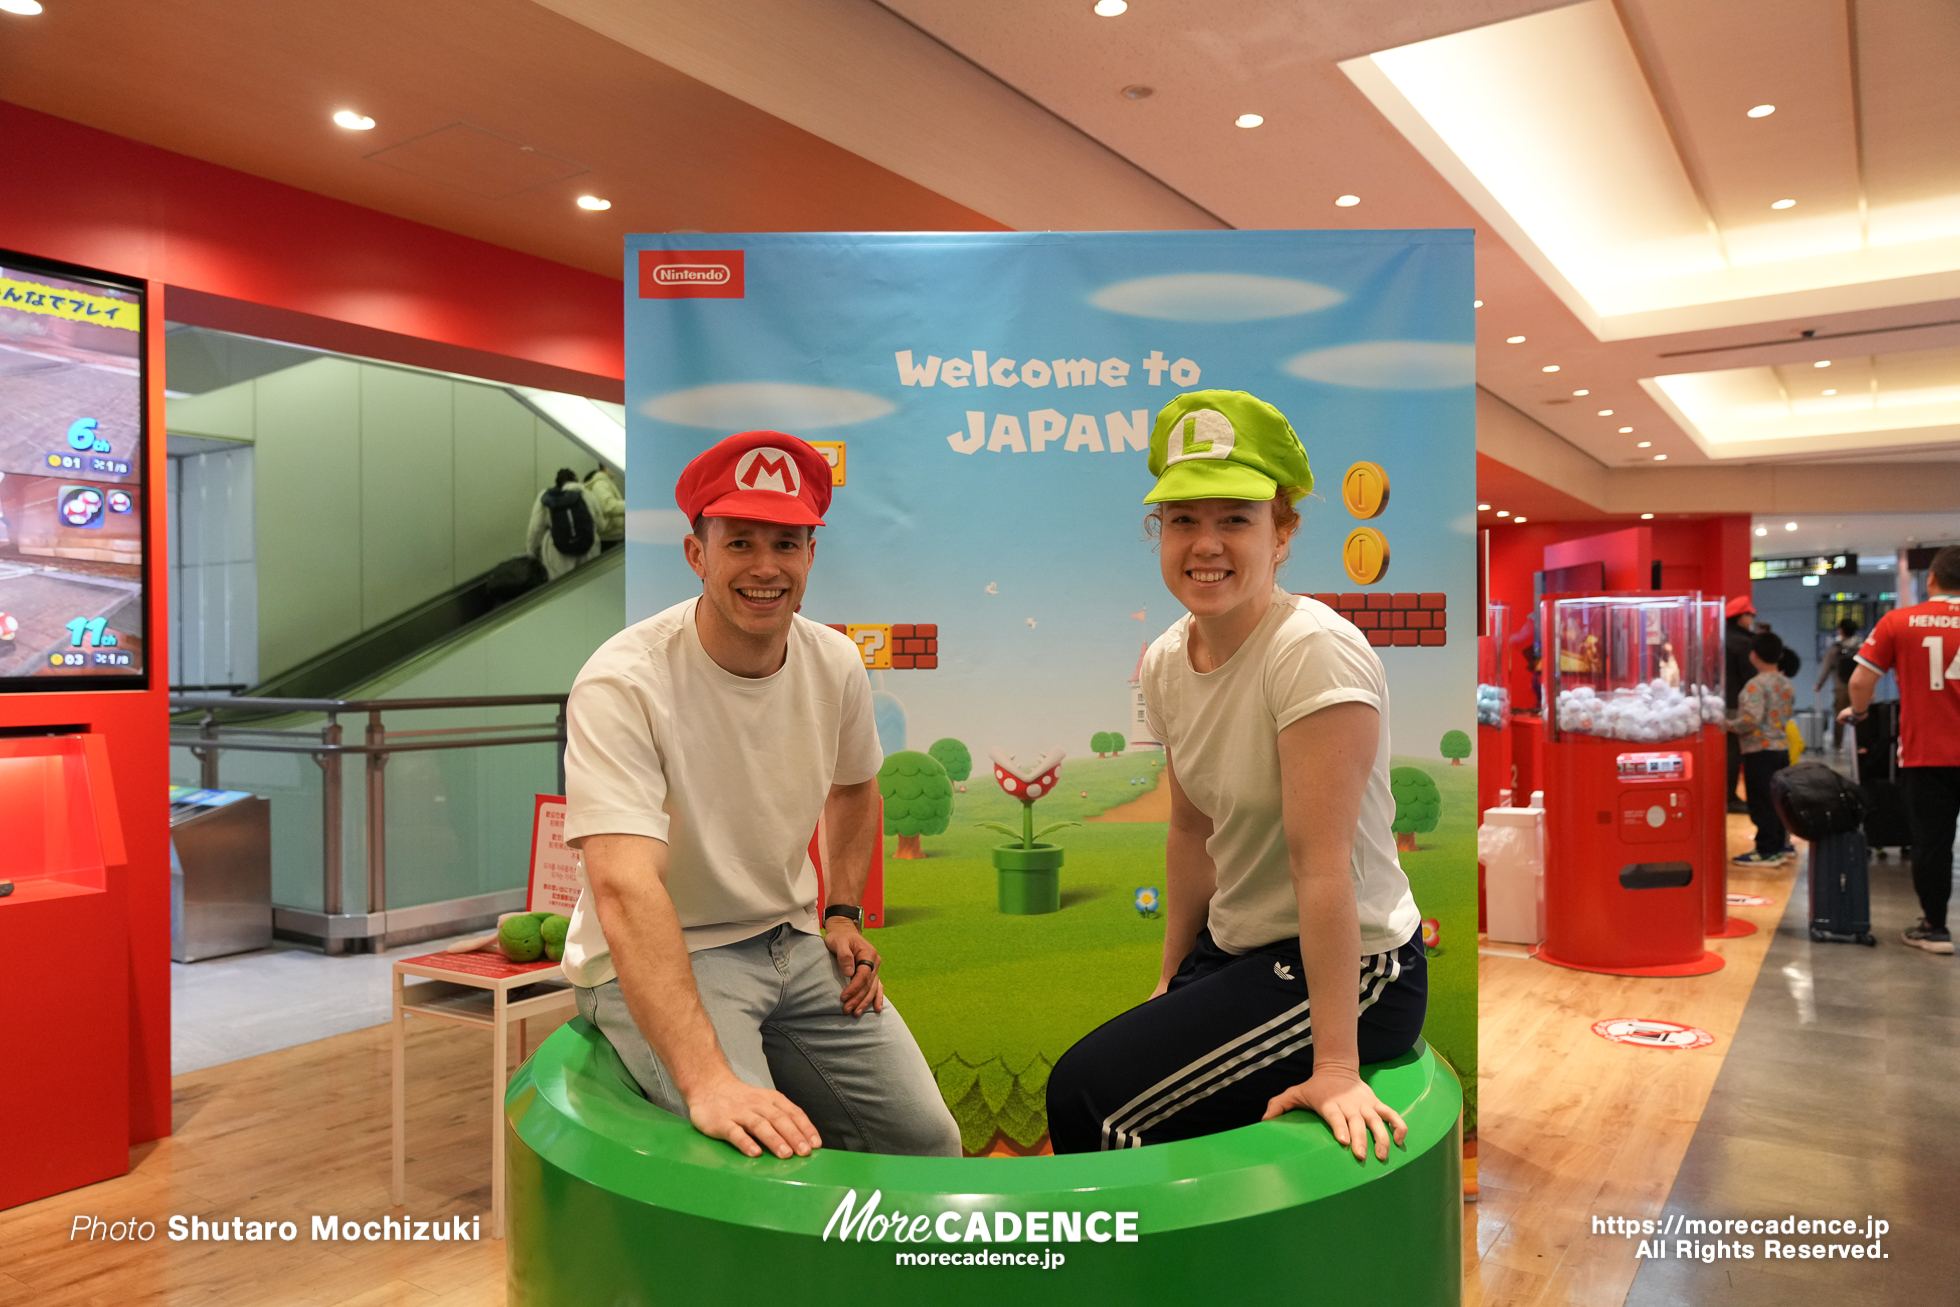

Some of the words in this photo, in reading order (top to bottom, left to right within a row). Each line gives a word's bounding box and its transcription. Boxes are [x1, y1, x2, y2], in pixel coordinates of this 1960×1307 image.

[660, 269, 723, 281] Nintendo
[0, 287, 120, 320] んなでプレイ
[894, 349, 1131, 389] Welcome
[1142, 349, 1202, 388] to
[946, 408, 1149, 455] JAPAN
[1182, 417, 1214, 456] L
[740, 451, 797, 493] M
